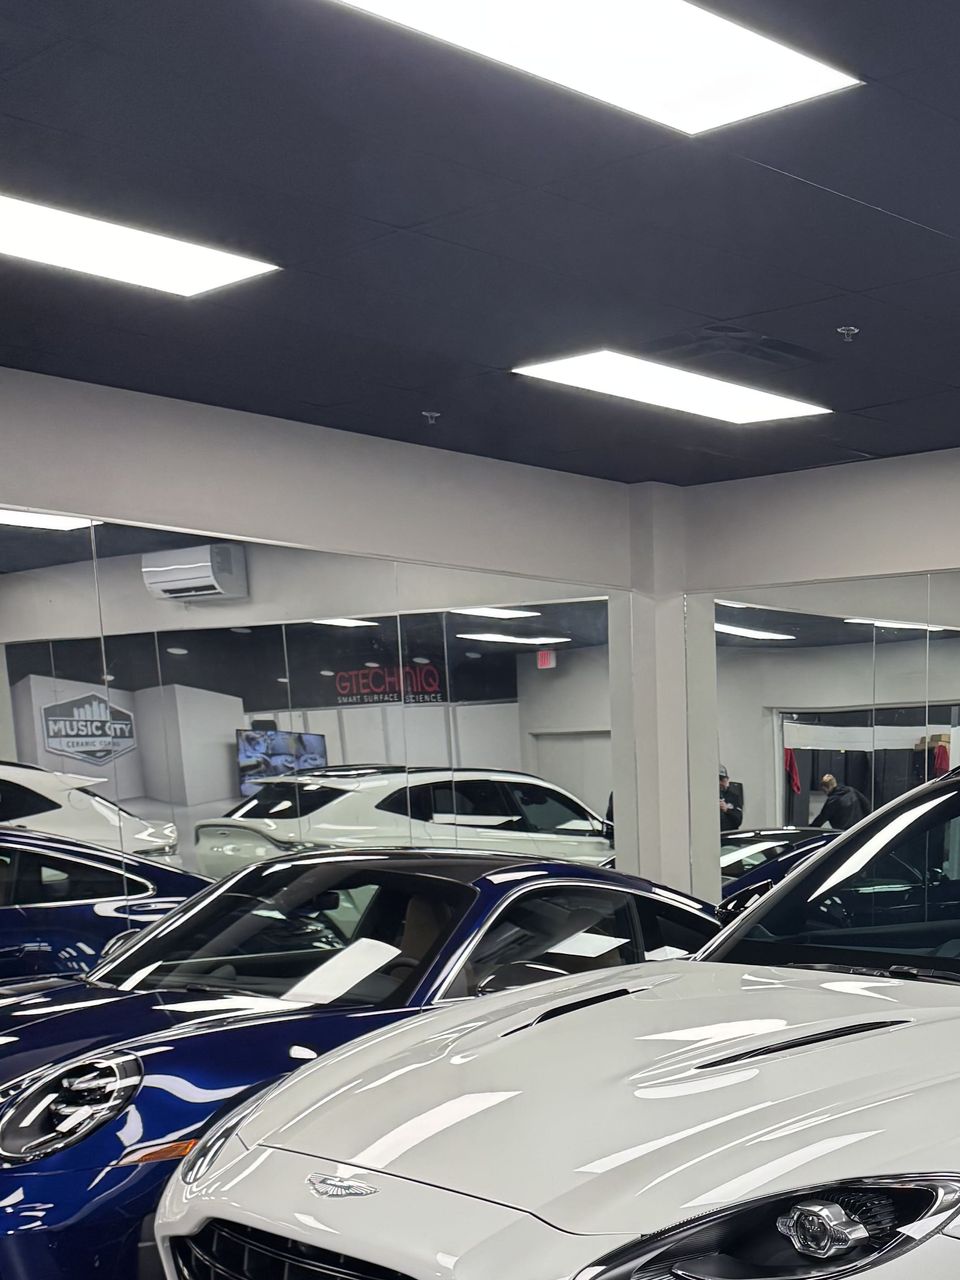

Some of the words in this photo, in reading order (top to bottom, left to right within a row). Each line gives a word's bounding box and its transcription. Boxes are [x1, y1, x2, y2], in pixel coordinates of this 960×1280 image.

[335, 665, 440, 694] GTECHNIQ
[337, 695, 361, 703] SMART
[363, 693, 399, 702] SURFACE
[404, 693, 442, 703] SCIENCE
[48, 720, 102, 736] MUSIC
[105, 721, 131, 736] CITY
